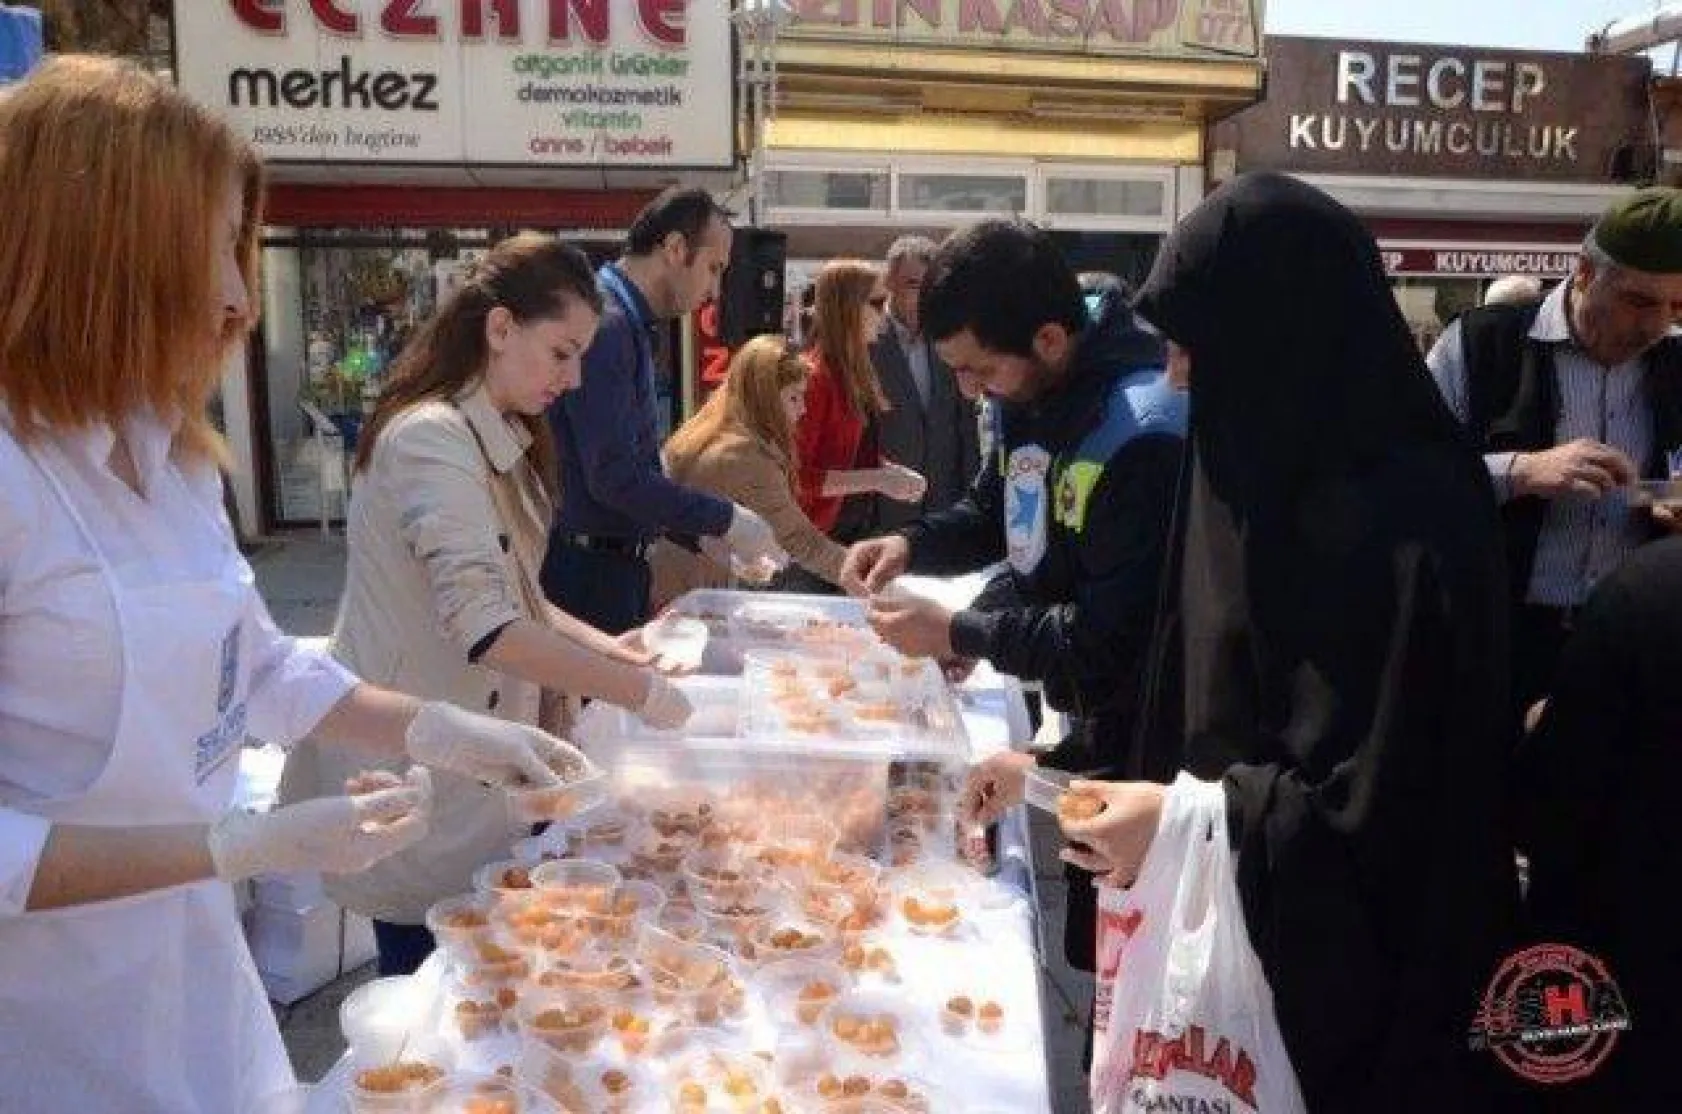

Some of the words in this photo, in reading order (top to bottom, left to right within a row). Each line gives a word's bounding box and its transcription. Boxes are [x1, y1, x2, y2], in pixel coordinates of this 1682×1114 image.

[514, 53, 602, 78] organik
[229, 55, 439, 110] merkez
[517, 83, 682, 105] dermokozmetik
[1337, 51, 1546, 113] RECEP
[562, 110, 642, 129] vitamin
[530, 138, 585, 154] anne
[605, 135, 674, 155] bebek
[1290, 115, 1578, 160] KUYUMCULUK
